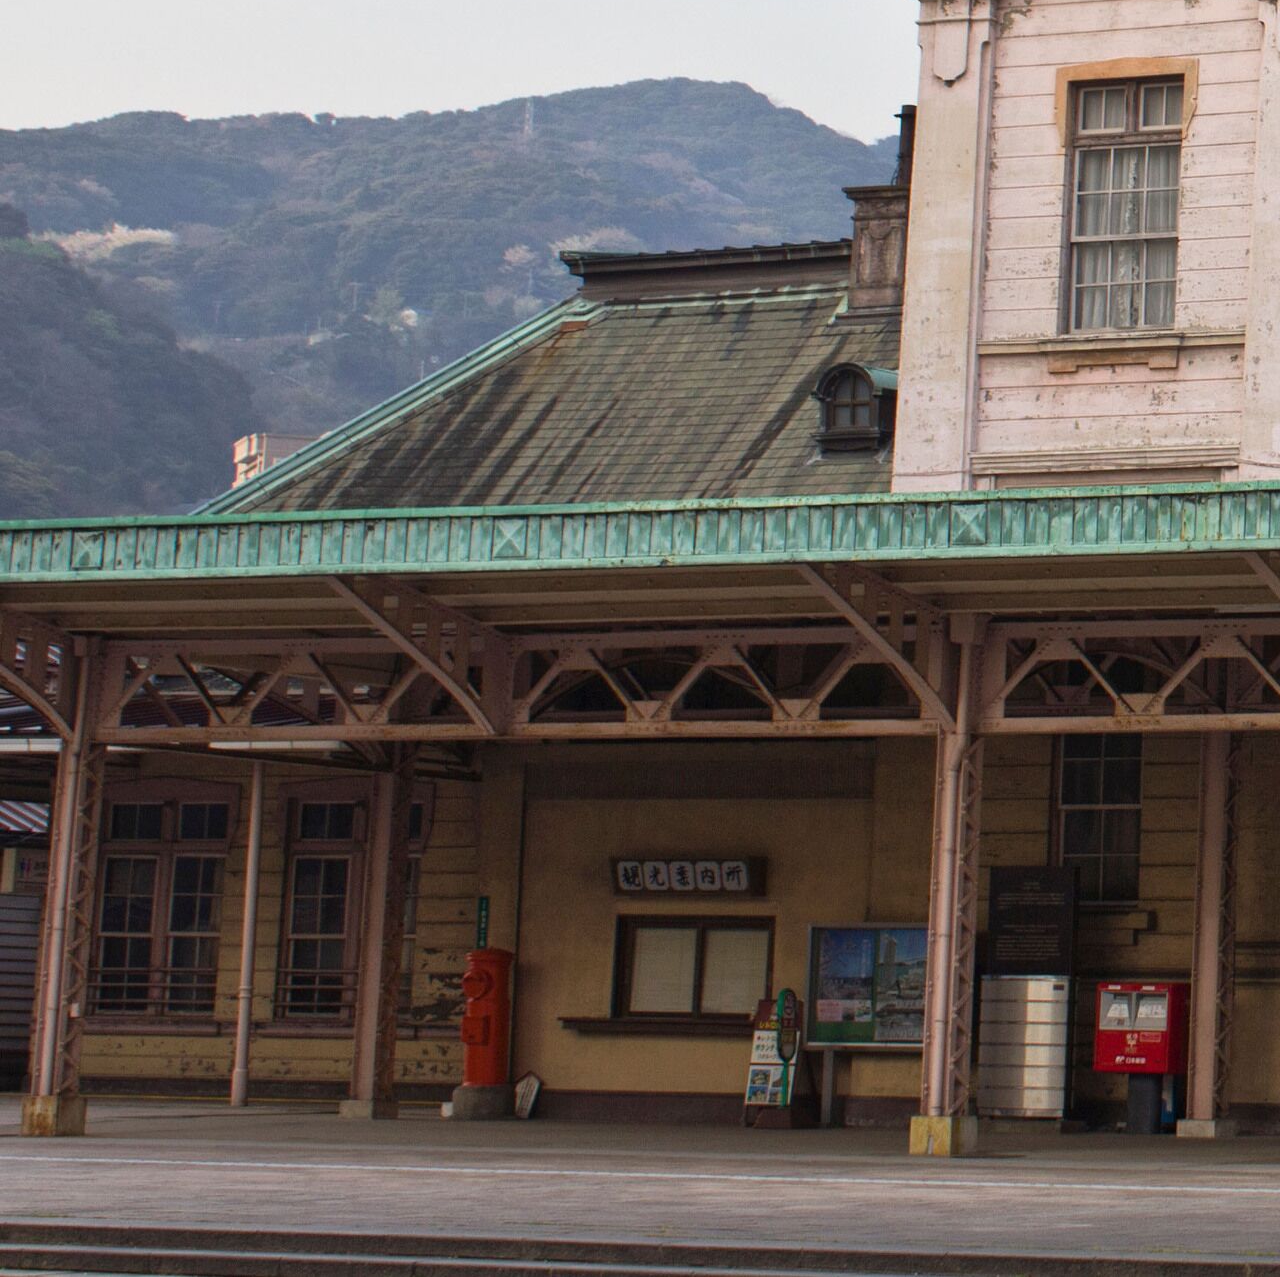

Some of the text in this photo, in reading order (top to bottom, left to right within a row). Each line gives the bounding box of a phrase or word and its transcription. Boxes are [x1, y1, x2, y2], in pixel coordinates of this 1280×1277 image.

[622, 865, 743, 887] 観光案内所
